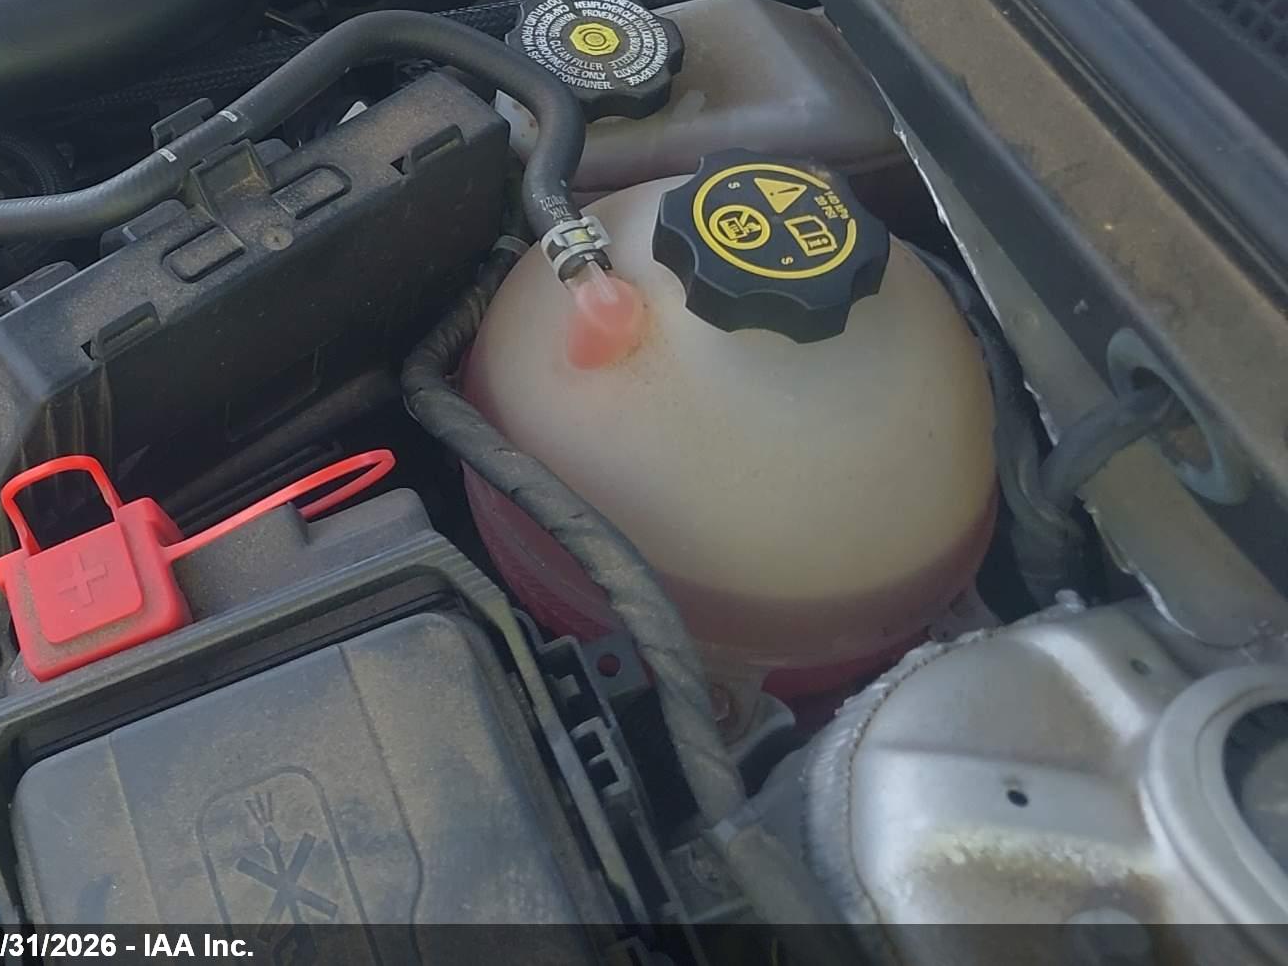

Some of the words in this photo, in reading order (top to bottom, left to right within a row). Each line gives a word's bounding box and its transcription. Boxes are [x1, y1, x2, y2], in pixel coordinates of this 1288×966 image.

[525, 8, 543, 25] FLUID
[553, 4, 569, 16] CAP
[582, 10, 628, 25] PROVENANT
[624, 10, 638, 21] QUE
[535, 13, 555, 35] BEFORE
[521, 25, 534, 46] FROM
[549, 40, 571, 60] CLEAN
[570, 58, 603, 70] FILLER
[581, 70, 606, 80] ONLY
